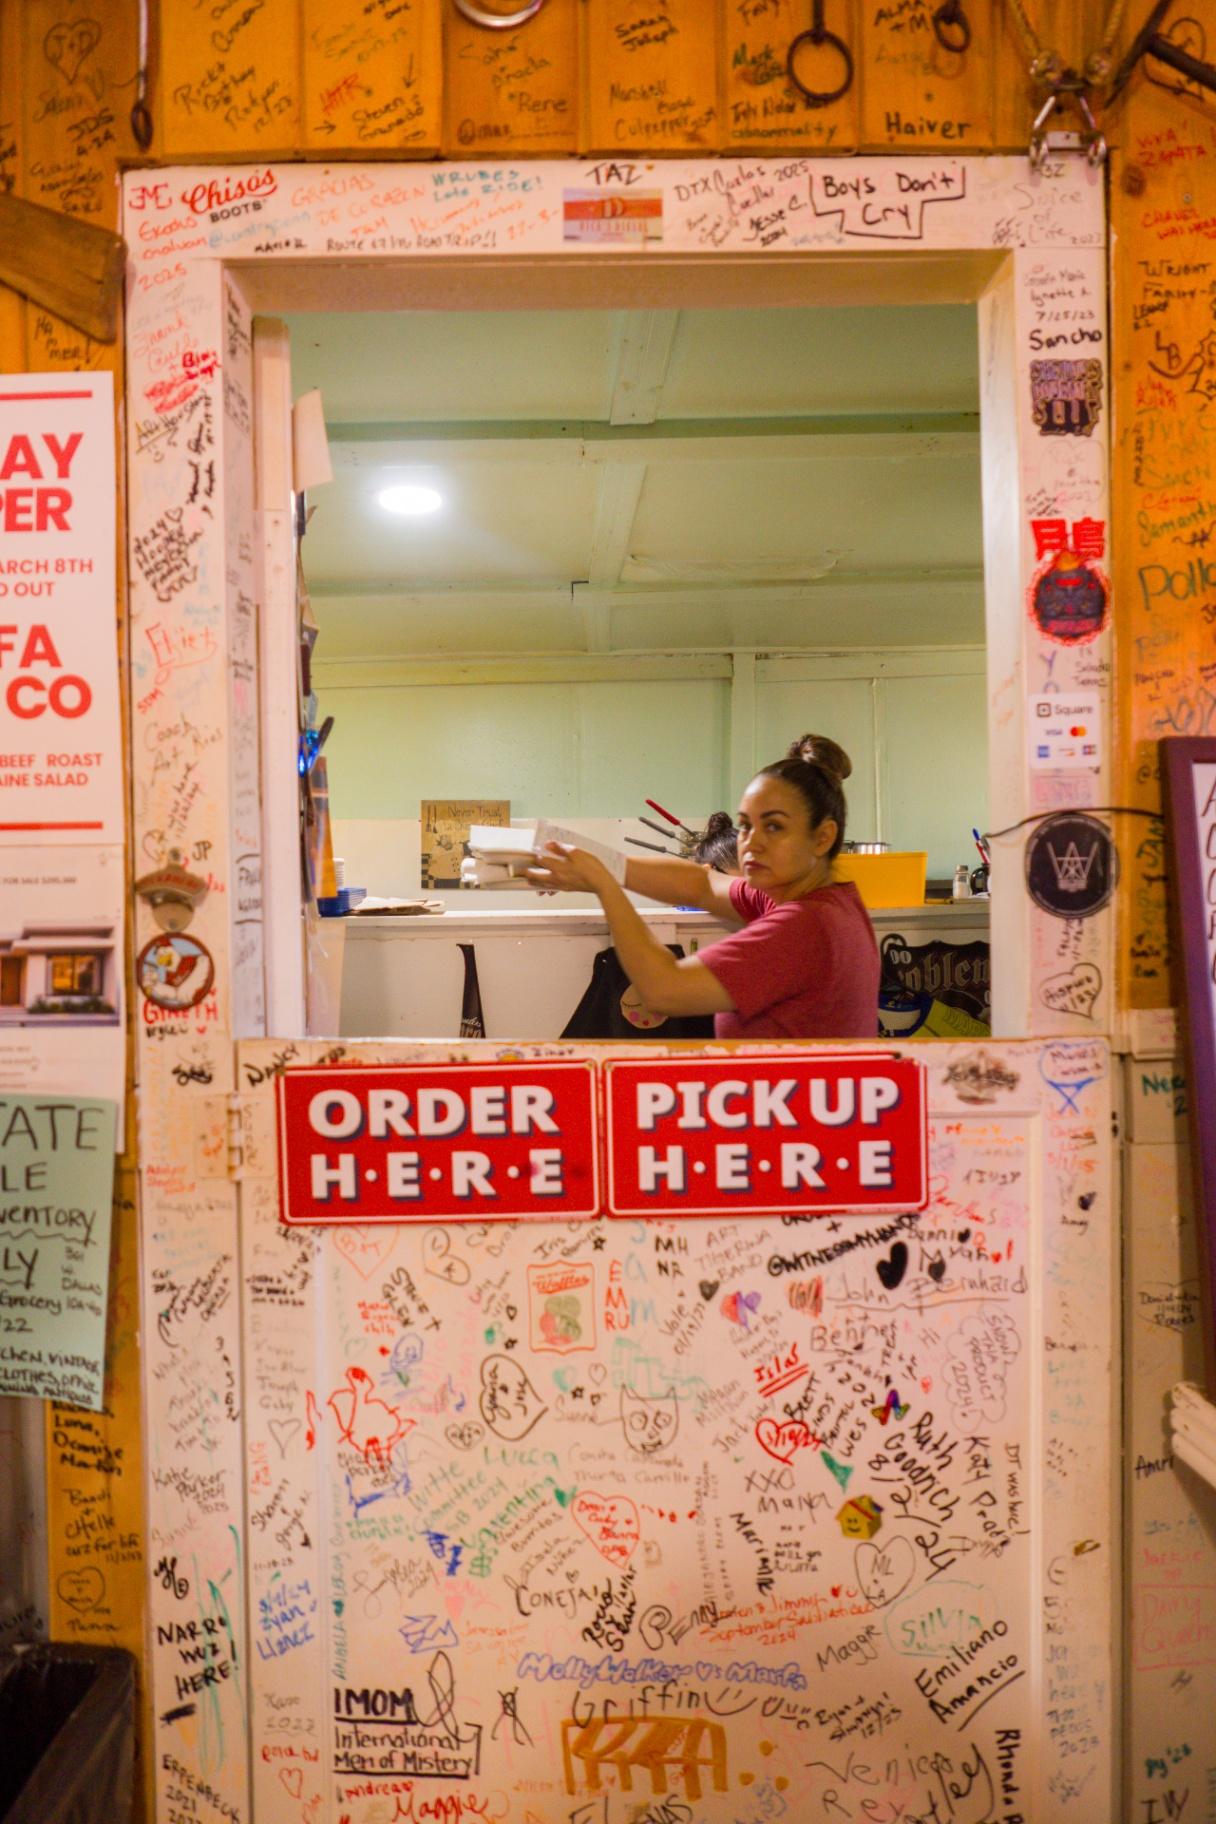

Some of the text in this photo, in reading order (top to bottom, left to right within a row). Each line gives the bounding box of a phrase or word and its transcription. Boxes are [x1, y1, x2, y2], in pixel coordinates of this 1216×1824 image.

[886, 112, 971, 141] Haiver
[585, 162, 643, 186] TAZ
[823, 172, 955, 199] Boys Don't
[210, 202, 262, 223] BOOTS
[862, 204, 912, 230] Cry
[1028, 327, 1103, 352] Sancho
[0, 487, 73, 532] ER
[54, 559, 93, 574] 8TH
[14, 582, 55, 597] OUT
[6, 674, 92, 720] CO
[1055, 705, 1093, 717] Square
[47, 753, 103, 767] ROAST
[34, 773, 88, 787] SALAD
[308, 1084, 561, 1139] ORDER
[909, 1411, 958, 1471] Ruth
[884, 1432, 961, 1523] Goodrich
[914, 1620, 1009, 1699] Emiliano
[333, 1686, 415, 1717] IMOM
[928, 1654, 1018, 1725] Amancio
[571, 1679, 701, 1729] Griffin
[334, 1722, 461, 1751] International
[334, 1751, 473, 1775] Men of Mistery
